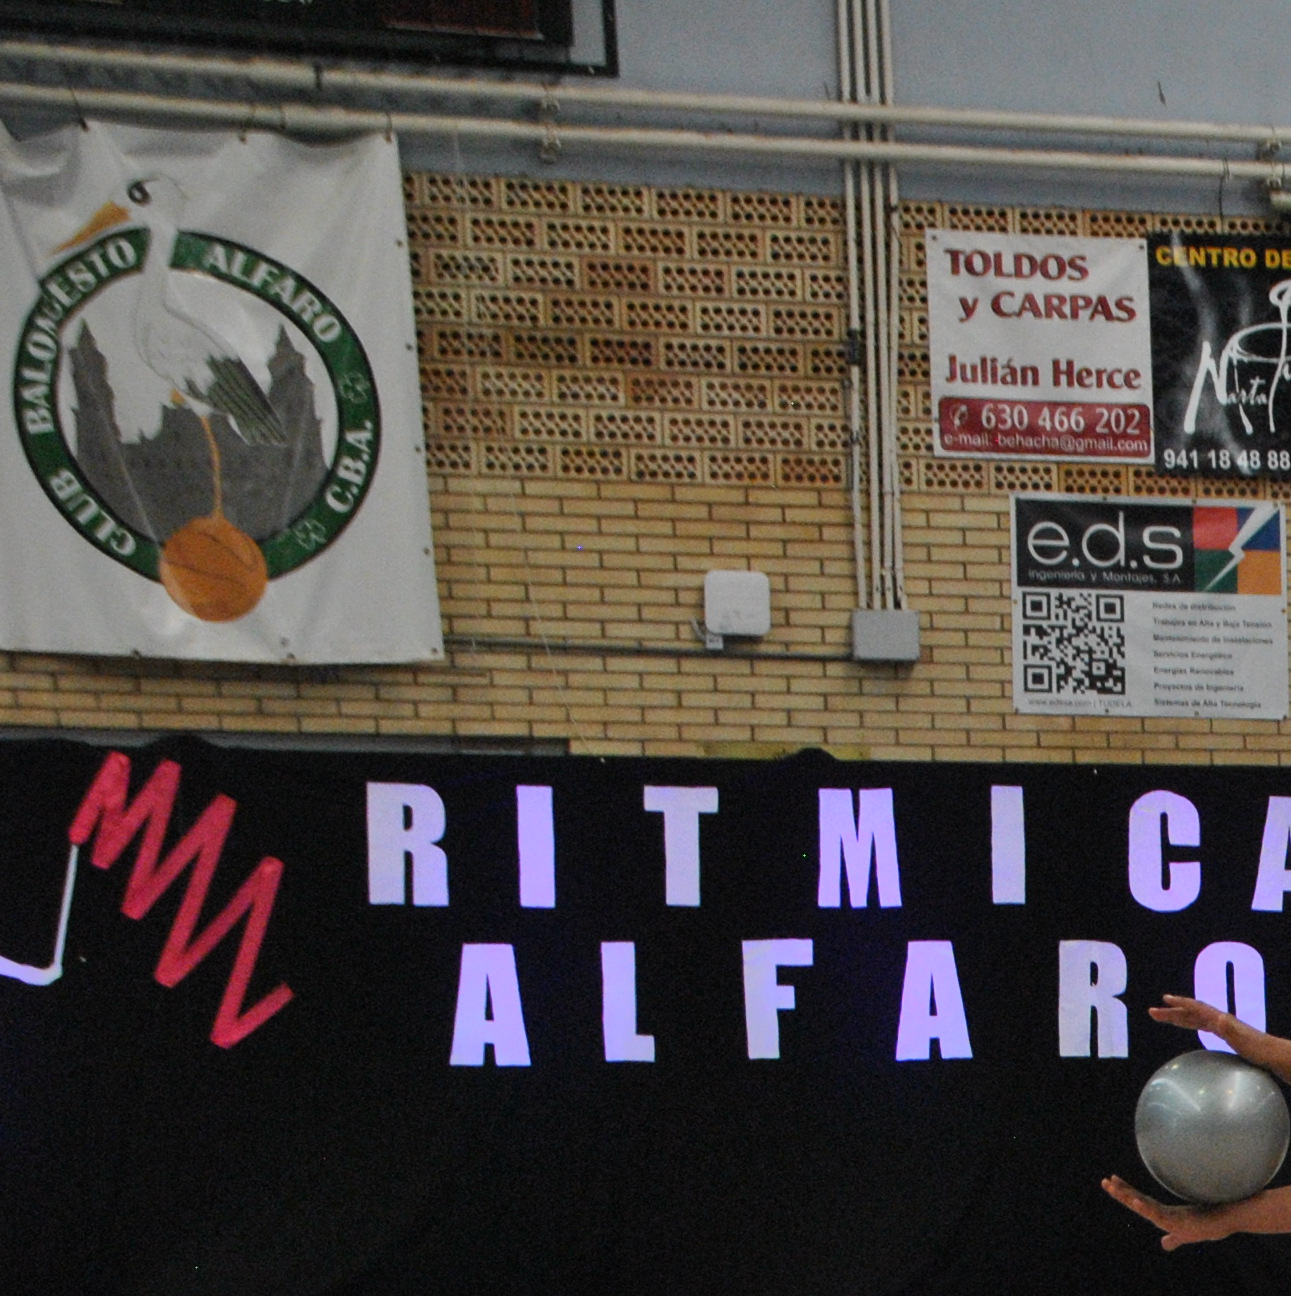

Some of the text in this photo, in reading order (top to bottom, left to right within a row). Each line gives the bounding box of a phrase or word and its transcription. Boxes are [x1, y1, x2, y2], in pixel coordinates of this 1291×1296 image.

[944, 248, 1090, 281] TOLDOS
[1156, 245, 1258, 269] CENTRO
[959, 291, 1137, 323] y CARPAS
[945, 355, 1142, 389] Julián Herce
[50, 467, 136, 556] CLUB
[204, 244, 341, 343] ALFARO
[981, 404, 1141, 435] 630 466 202
[326, 420, 373, 512] C.B.A.
[1164, 448, 1199, 470] 941
[1209, 449, 1231, 470] 18
[1236, 450, 1261, 471] 48
[1267, 450, 1291, 471] 88
[1027, 510, 1184, 570] e.d.s
